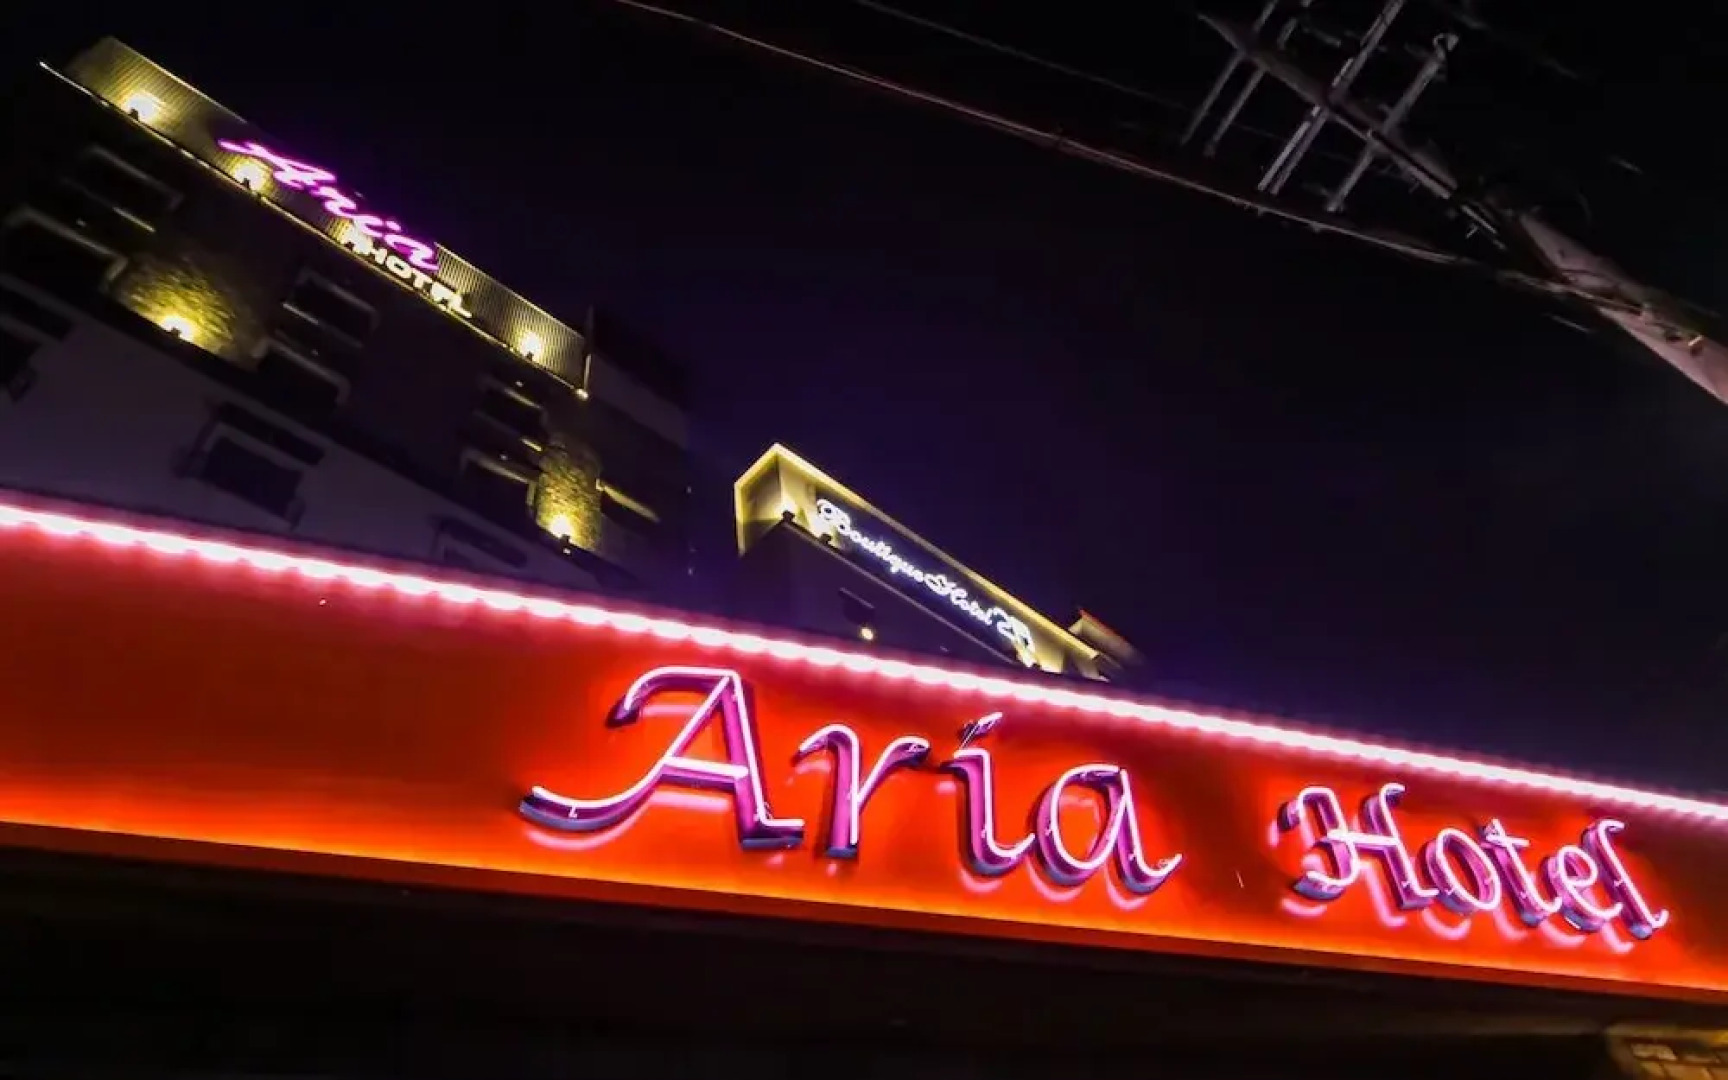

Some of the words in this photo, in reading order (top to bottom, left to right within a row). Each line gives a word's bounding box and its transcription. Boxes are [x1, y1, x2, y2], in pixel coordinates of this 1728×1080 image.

[217, 138, 440, 271] Aria
[353, 235, 472, 318] HOTEL
[817, 498, 924, 583] Boutique
[922, 573, 994, 625] Hotel
[521, 666, 1182, 893] Aria
[1277, 784, 1669, 940] Hotel
